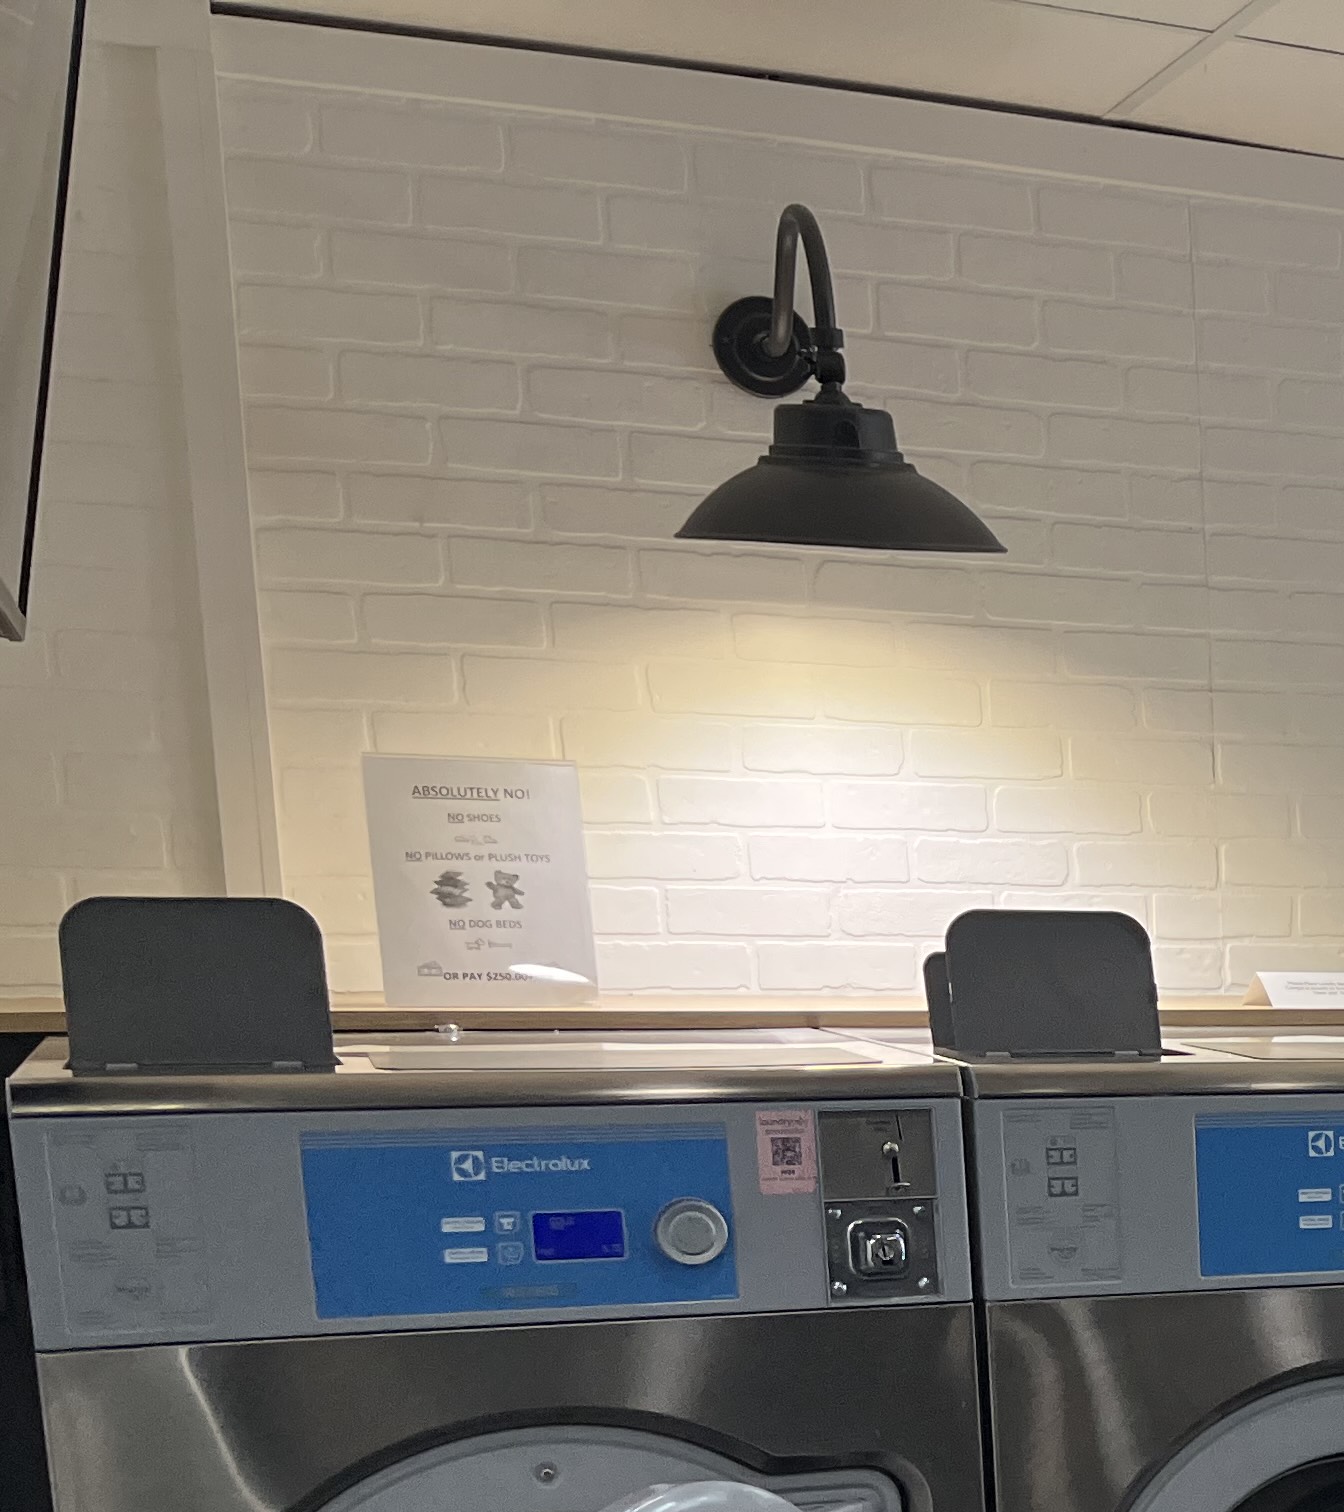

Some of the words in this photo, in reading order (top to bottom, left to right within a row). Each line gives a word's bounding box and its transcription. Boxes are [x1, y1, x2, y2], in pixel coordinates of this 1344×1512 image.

[411, 785, 501, 799] ABSOLUTELY
[503, 788, 531, 800] NO!
[447, 812, 465, 823] NO
[466, 813, 502, 823] SHOES
[405, 851, 423, 862] NO
[424, 851, 472, 862] PILLOWS
[473, 854, 485, 862] or
[488, 852, 522, 863] PLUSH
[524, 853, 551, 864] TOYS
[448, 919, 466, 930] NO
[468, 919, 492, 929] DOG
[495, 919, 523, 929] BEDS
[443, 971, 460, 982] OR
[462, 971, 483, 982] PAY
[490, 1155, 592, 1173] Electrolux
